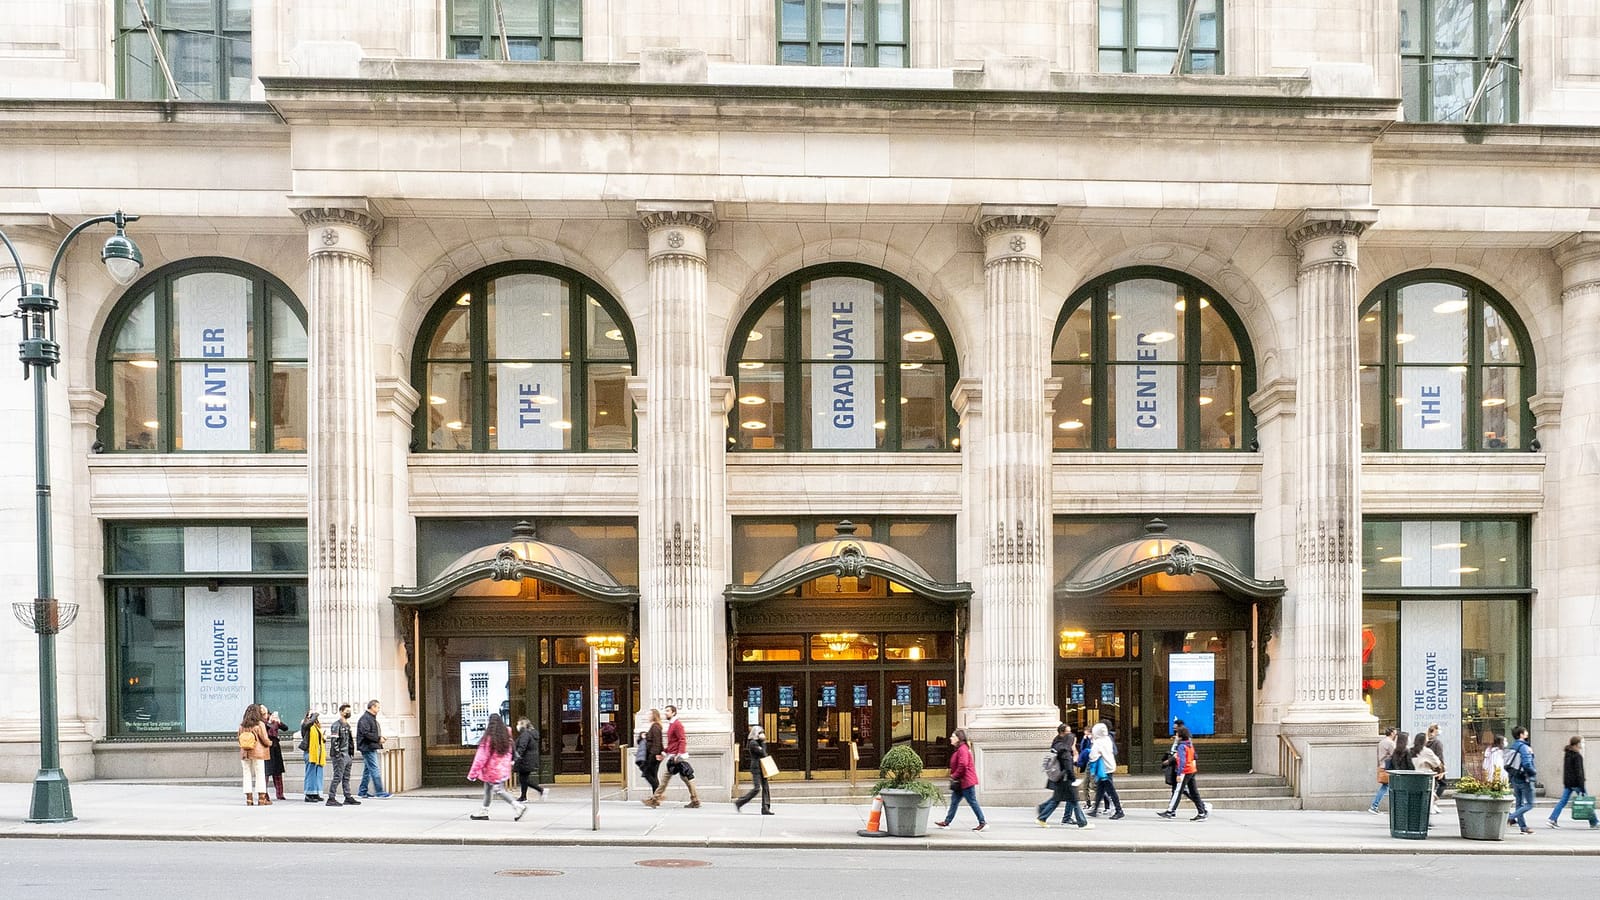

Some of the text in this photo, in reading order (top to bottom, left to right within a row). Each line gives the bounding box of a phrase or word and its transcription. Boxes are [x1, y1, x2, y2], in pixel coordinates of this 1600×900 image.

[203, 328, 227, 429] CENTER
[832, 301, 854, 429] GRADUATE
[519, 383, 541, 429] THE
[1421, 386, 1441, 429] THE
[200, 659, 212, 683] THE
[213, 619, 225, 682] GRADUATE
[227, 636, 239, 682] CENTER
[1414, 689, 1425, 711] THE
[1426, 651, 1437, 710] GRADUATE
[1437, 668, 1448, 710] CENTER
